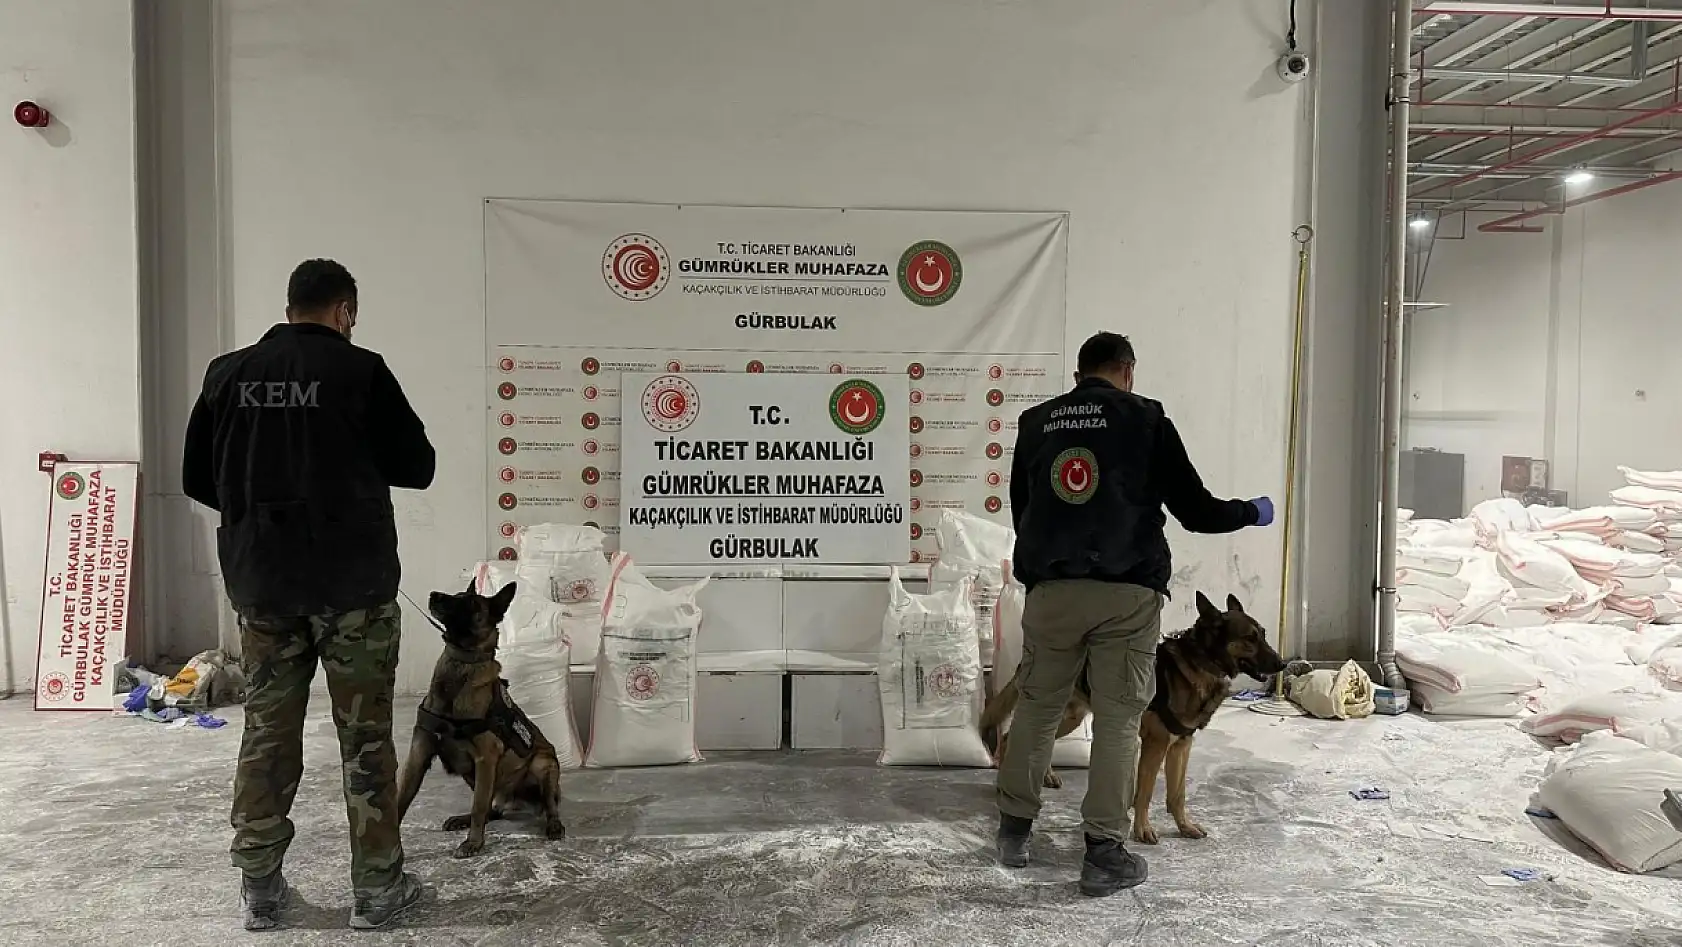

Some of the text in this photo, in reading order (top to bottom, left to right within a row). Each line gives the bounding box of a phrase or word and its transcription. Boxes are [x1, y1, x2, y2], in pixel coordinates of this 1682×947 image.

[717, 241, 856, 257] T.C. TİCARET BAKANLIĞI
[678, 258, 889, 276] GÜMRÜKLER MUHAFAZA
[682, 284, 886, 297] KAÇAKÇILIK VE İSTİHBARAT MÜDÜRLÜĞÜ
[734, 312, 837, 330] GÜRBULAK
[237, 381, 321, 408] KEM
[749, 405, 790, 425] T.C.
[1050, 402, 1103, 419] GÜMRÜK
[1043, 418, 1108, 433] MUHAFAZA
[654, 436, 874, 461] TİCARET BAKANLIĞI
[643, 470, 885, 495] GÜMRÜKLER MUHAFAZA
[629, 507, 712, 530] KAÇAKÇILIK
[716, 507, 733, 524] VE
[737, 503, 816, 524] İSTİHBARAT
[820, 503, 903, 524] MÜDÜRLÜĞÜ
[709, 534, 819, 559] GÜRBULAK
[49, 572, 62, 597] T.C.
[60, 514, 83, 658] TİCARET BAKANLIĞI
[71, 470, 101, 702] GÜRBULAK GÜMRÜK MUHAFAZA
[91, 486, 116, 686] KAÇAKÇILIK VE İSTİHBARAT
[109, 539, 129, 632] MÜDÜRLÜĞÜ
